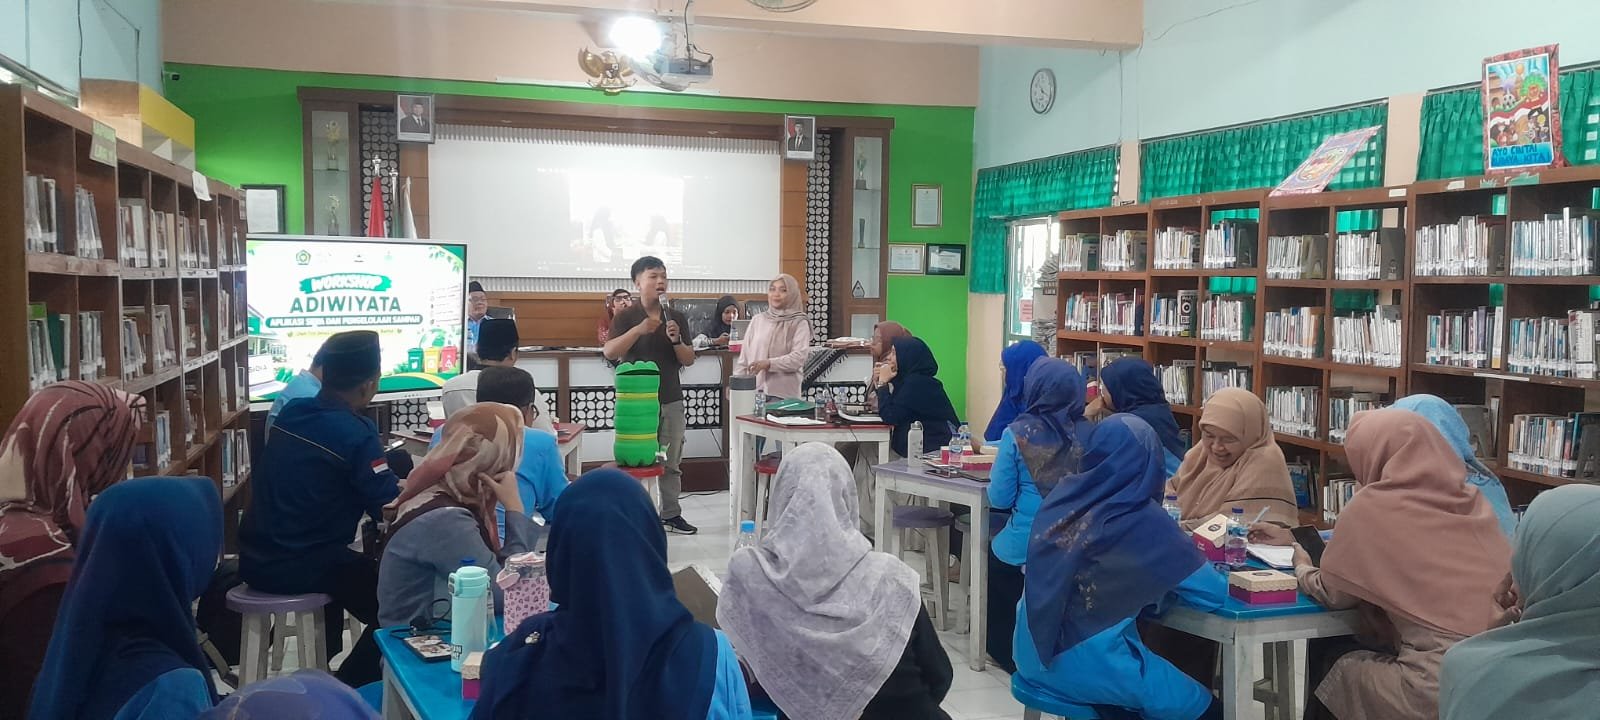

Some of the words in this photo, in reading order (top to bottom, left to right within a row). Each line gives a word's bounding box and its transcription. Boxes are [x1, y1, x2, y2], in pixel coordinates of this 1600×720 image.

[1493, 147, 1508, 156] AYO
[311, 274, 383, 291] WORKSHOP
[289, 296, 401, 313] ADIWIYATA
[270, 317, 305, 327] APLIKASI
